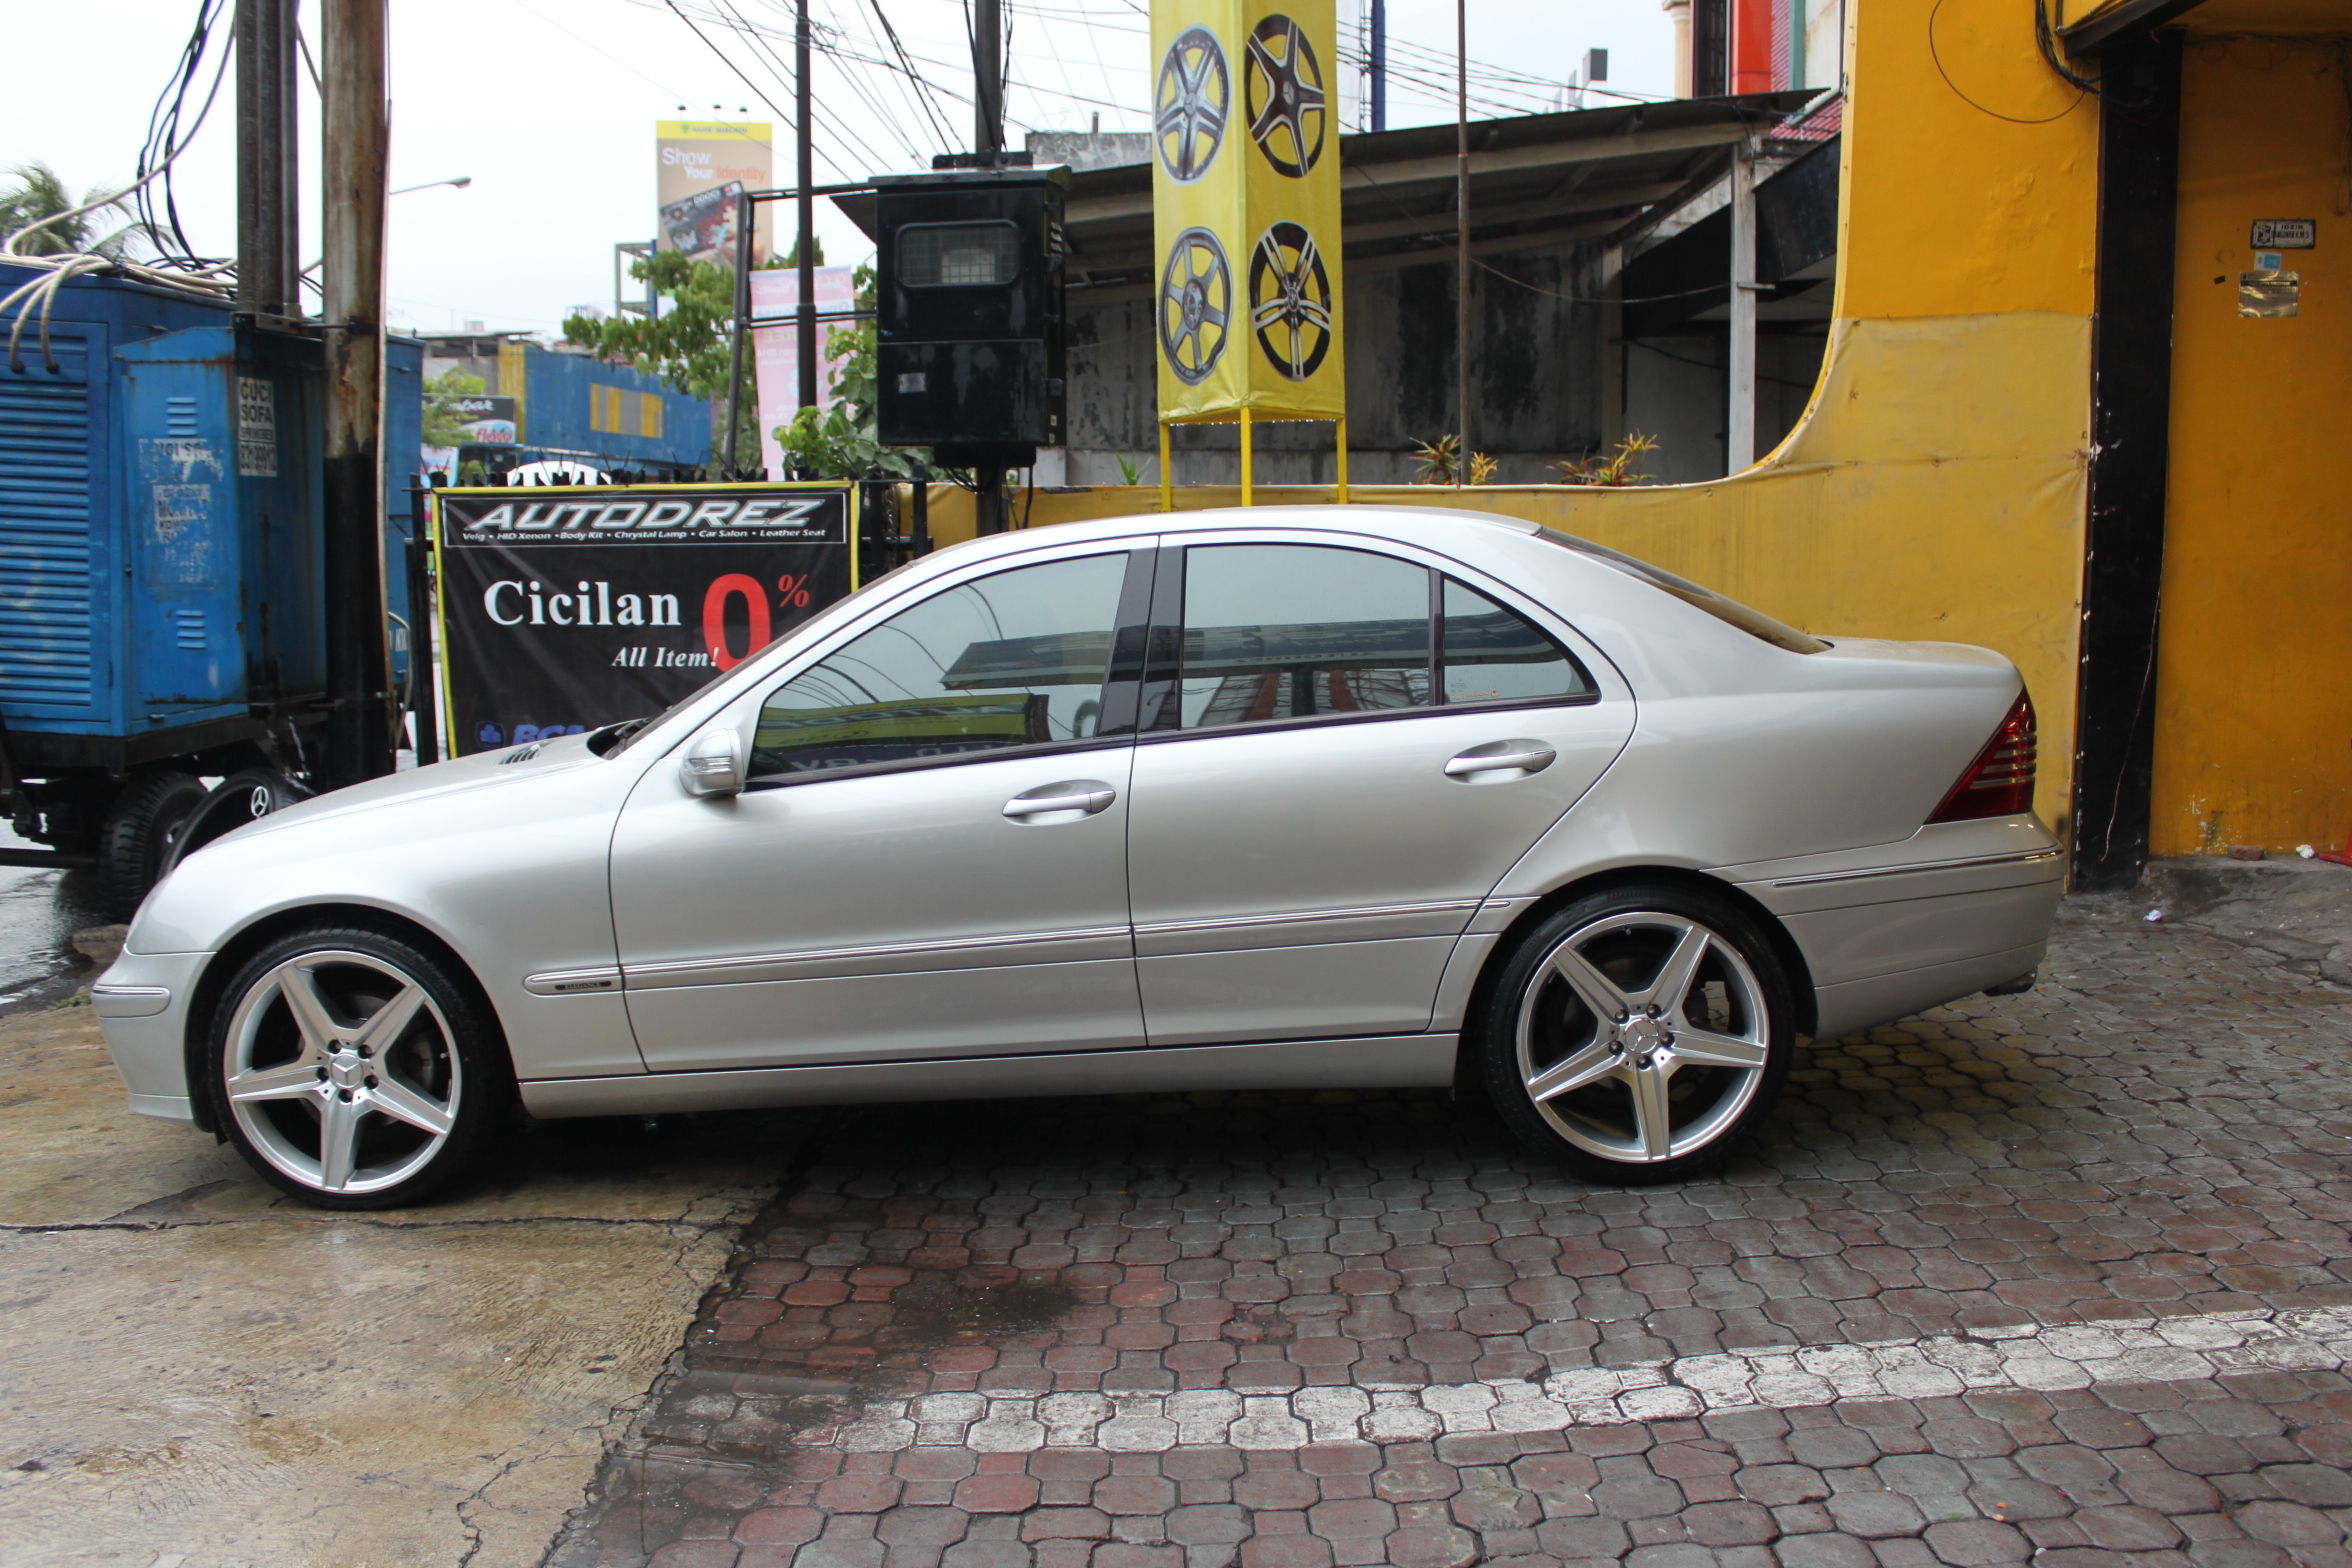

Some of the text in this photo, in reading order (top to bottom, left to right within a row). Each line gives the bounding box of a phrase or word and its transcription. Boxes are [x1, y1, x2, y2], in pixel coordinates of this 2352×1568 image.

[662, 147, 712, 166] Show
[684, 166, 766, 183] Your Identity
[241, 382, 272, 403] CUCI
[240, 404, 273, 424] SOFA
[476, 428, 513, 443] flow
[463, 500, 826, 531] AUTODREZ
[462, 529, 826, 542] Velg HID Xenon Body Kit Chrystal Lamp Car Salon Leather Seat
[484, 580, 682, 626] Cicilan
[611, 647, 720, 667] All Item!
